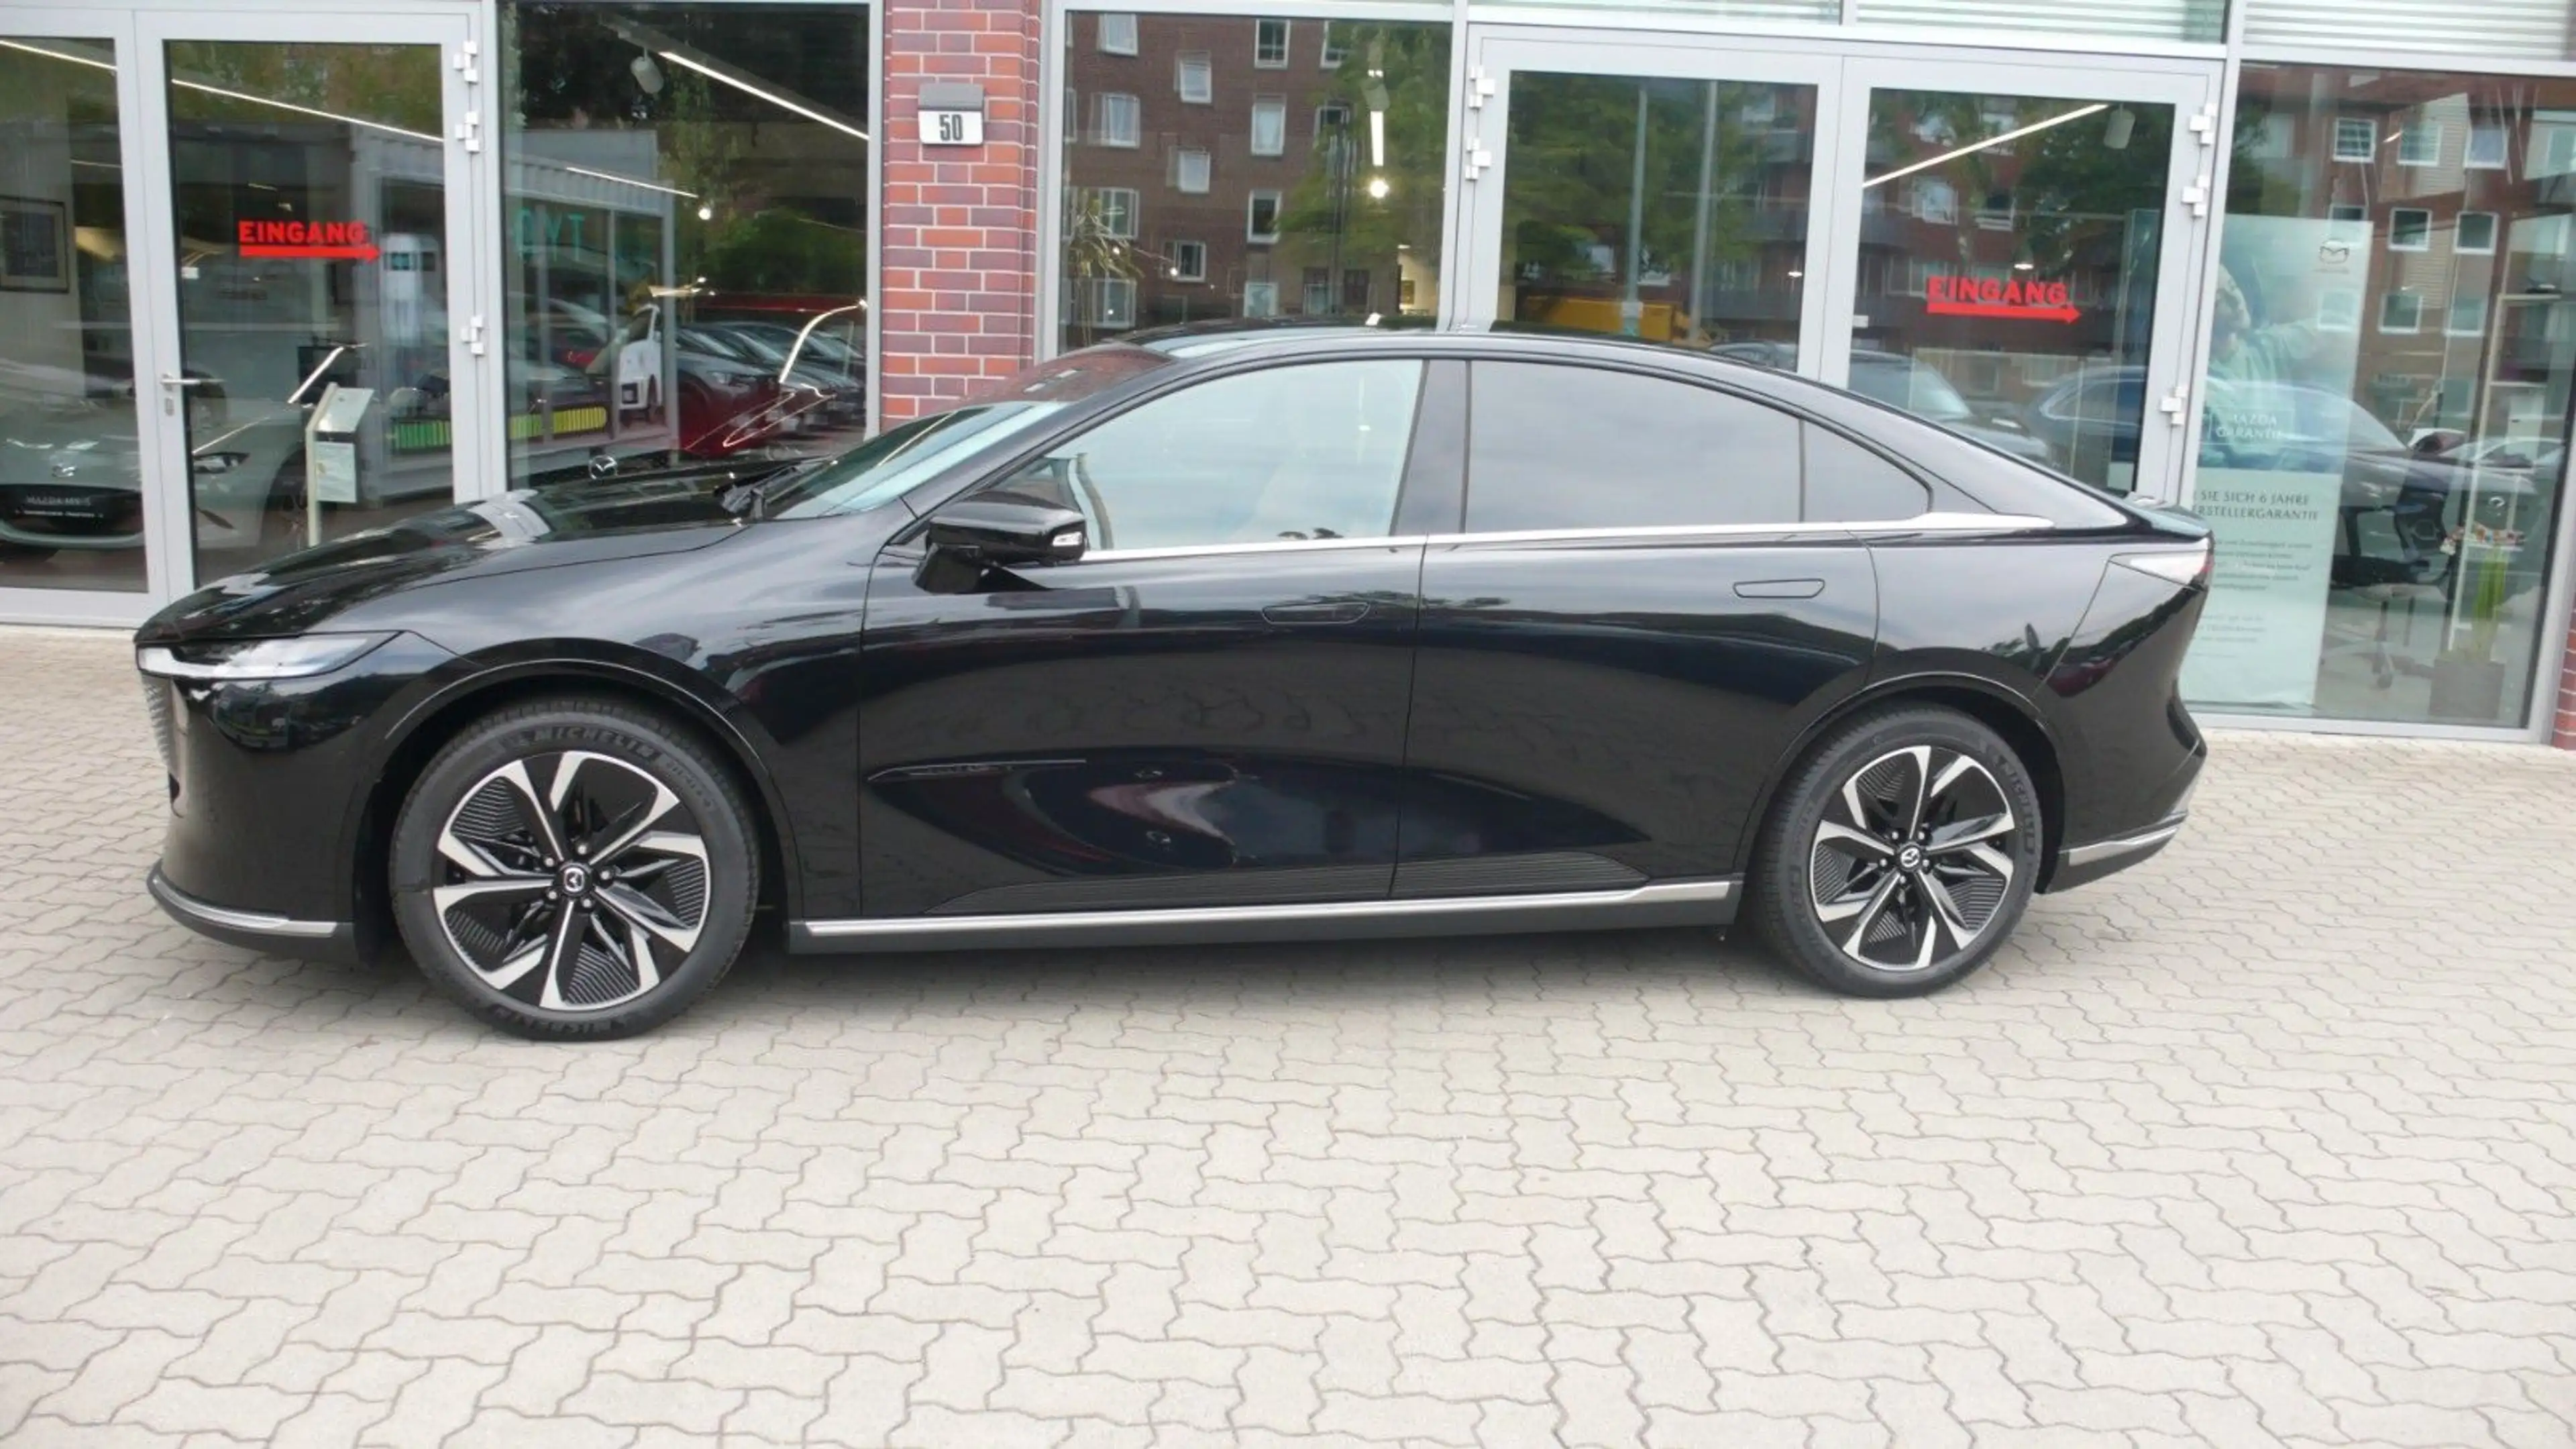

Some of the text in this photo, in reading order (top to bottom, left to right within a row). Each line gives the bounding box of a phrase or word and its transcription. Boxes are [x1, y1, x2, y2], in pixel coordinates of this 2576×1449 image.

[939, 114, 963, 141] 50
[239, 220, 366, 244] EINGANG
[1929, 276, 2067, 305] EINGANG
[2201, 490, 2219, 502] SIE
[2272, 492, 2310, 506] JAHRE
[533, 725, 657, 759] MICHELIN
